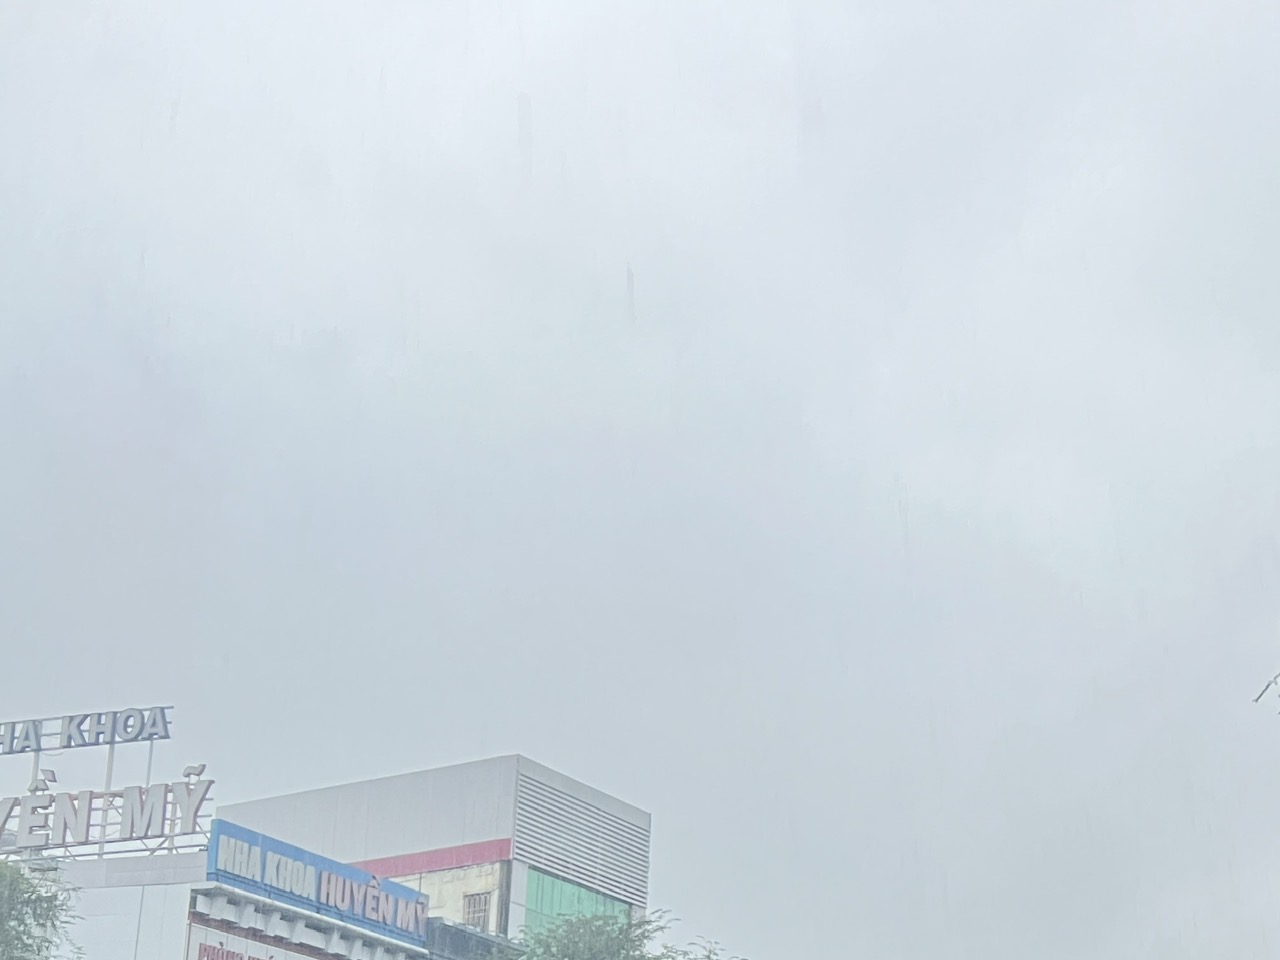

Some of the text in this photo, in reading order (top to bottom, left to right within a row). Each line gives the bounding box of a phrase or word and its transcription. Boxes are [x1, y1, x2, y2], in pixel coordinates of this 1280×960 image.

[60, 706, 170, 749] KHOA
[118, 763, 215, 840] MỸ
[216, 834, 262, 883] NHA
[263, 851, 317, 901] KHOA
[319, 870, 396, 926] HUYỀN
